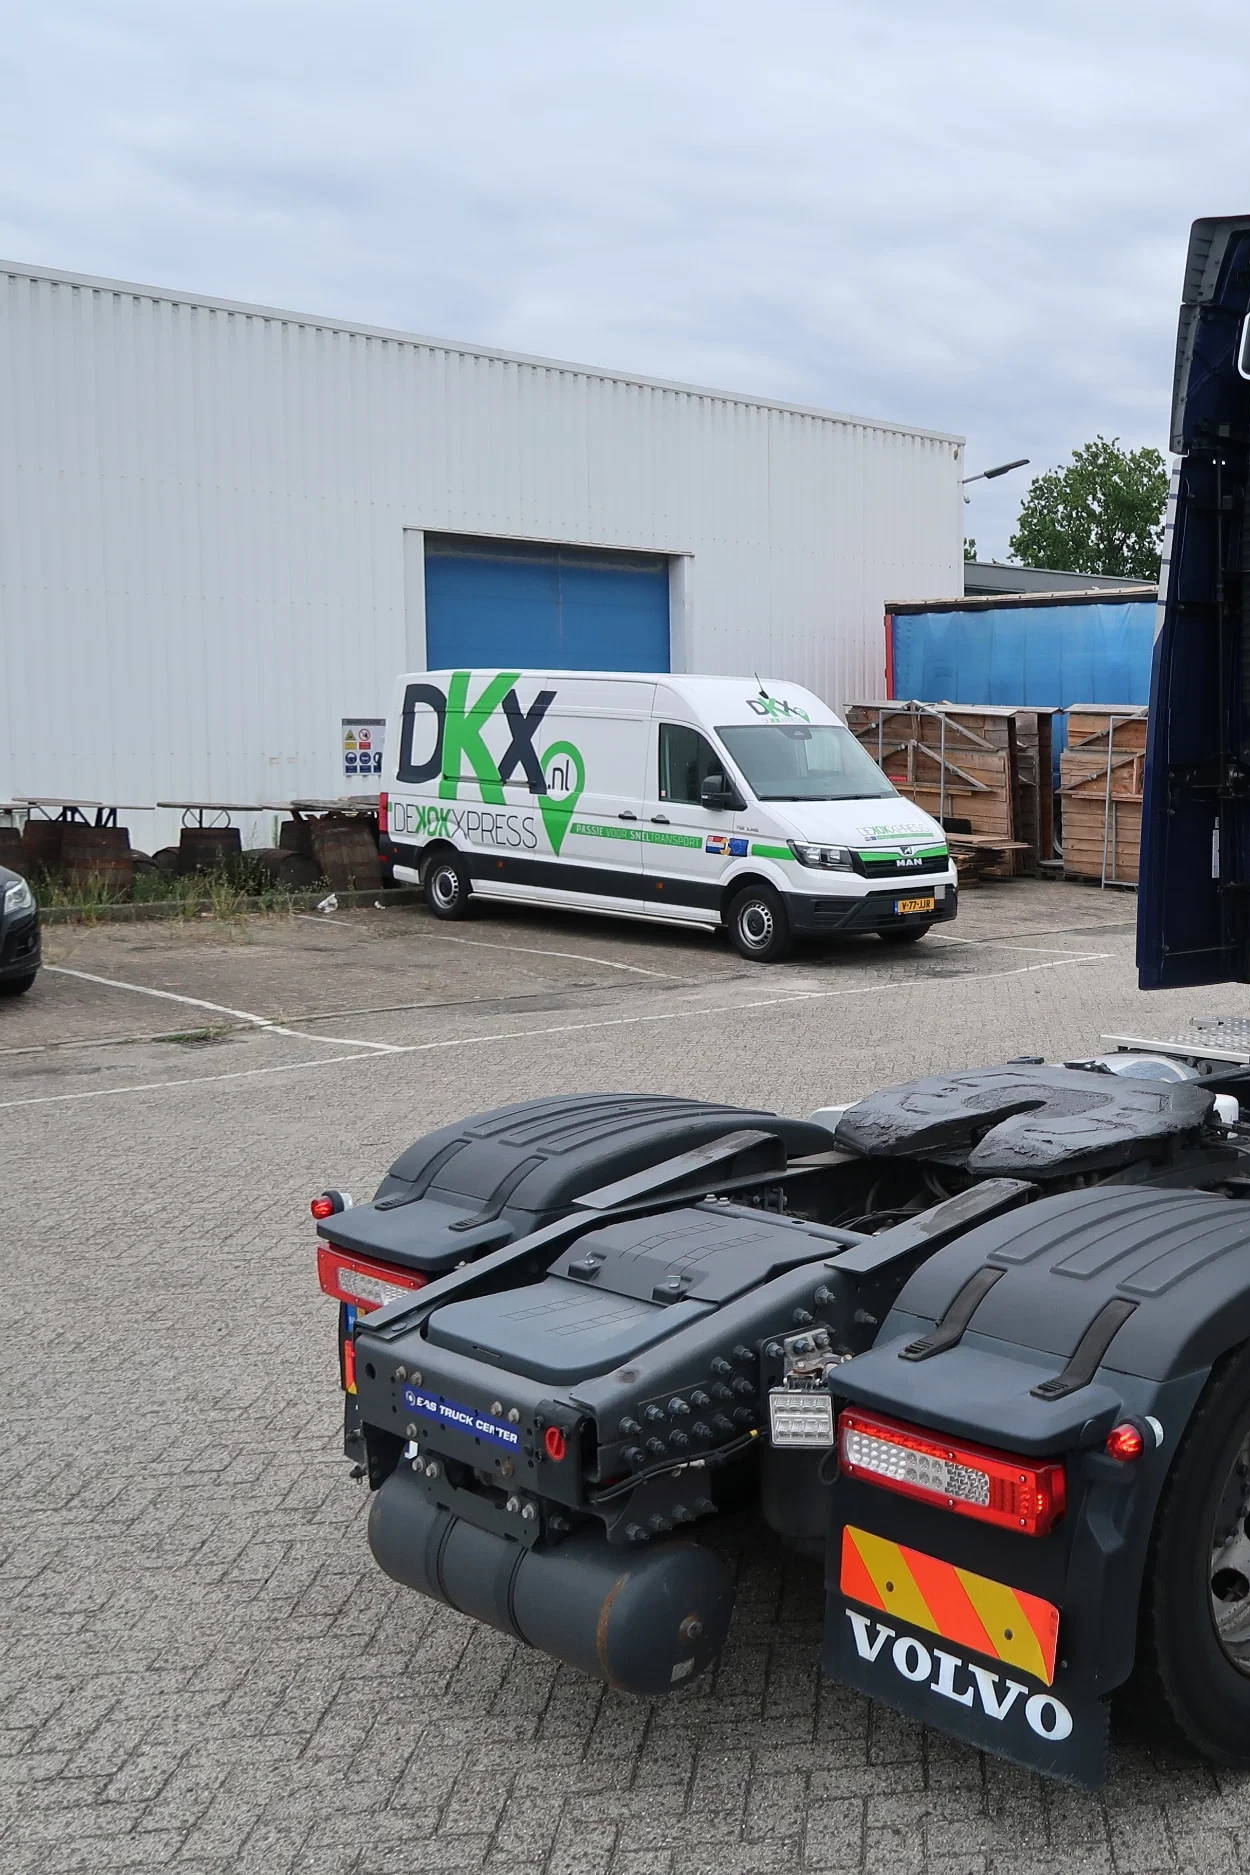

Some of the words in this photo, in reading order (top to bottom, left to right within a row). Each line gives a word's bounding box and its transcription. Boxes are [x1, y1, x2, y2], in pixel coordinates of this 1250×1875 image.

[745, 698, 799, 717] DKX
[396, 671, 557, 806] DKX
[394, 802, 538, 849] DEKOKXPRESS
[576, 824, 603, 836] PASSIE
[605, 827, 628, 839] VOOR
[629, 830, 700, 848] SNELTRANSPORT
[896, 858, 923, 867] MAN
[439, 1405, 474, 1427] TRUCK
[475, 1419, 518, 1444] CENTER
[845, 1608, 1074, 1741] VOLVO
